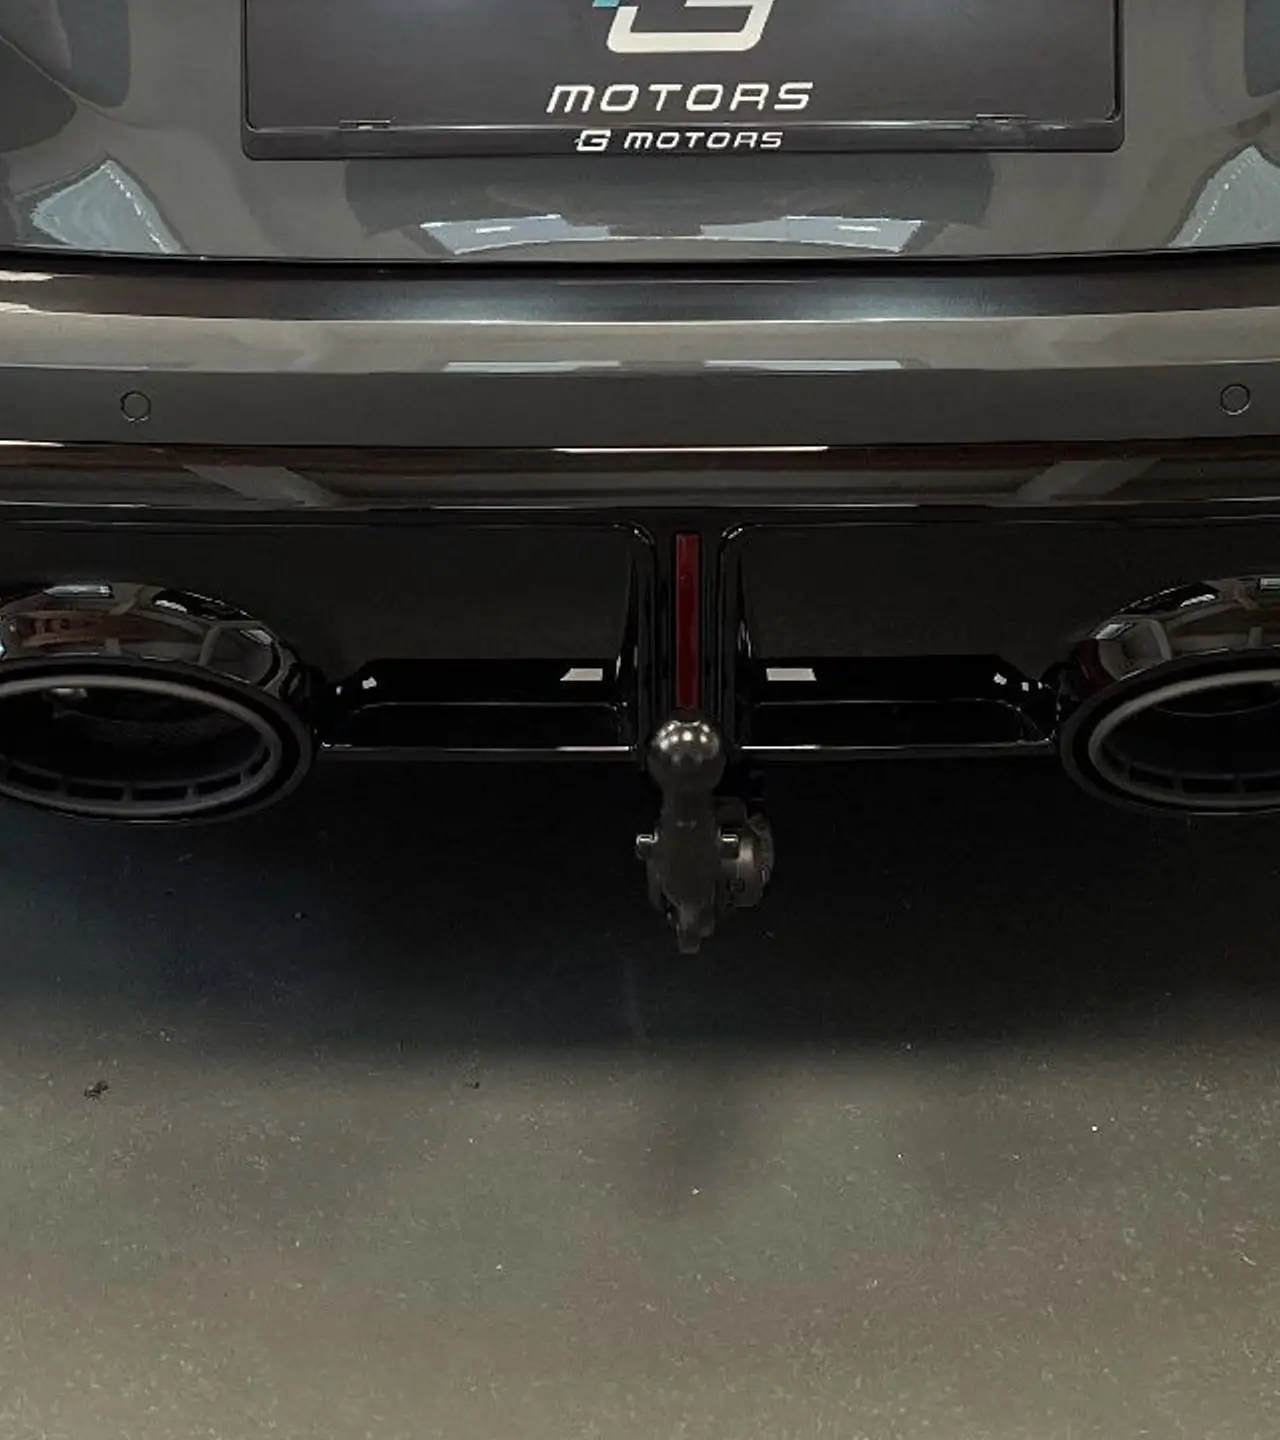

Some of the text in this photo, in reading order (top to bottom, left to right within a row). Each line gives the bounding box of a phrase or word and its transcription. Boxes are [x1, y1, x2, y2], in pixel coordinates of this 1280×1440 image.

[546, 81, 813, 113] MOTORS
[575, 128, 784, 152] G MOTORS
